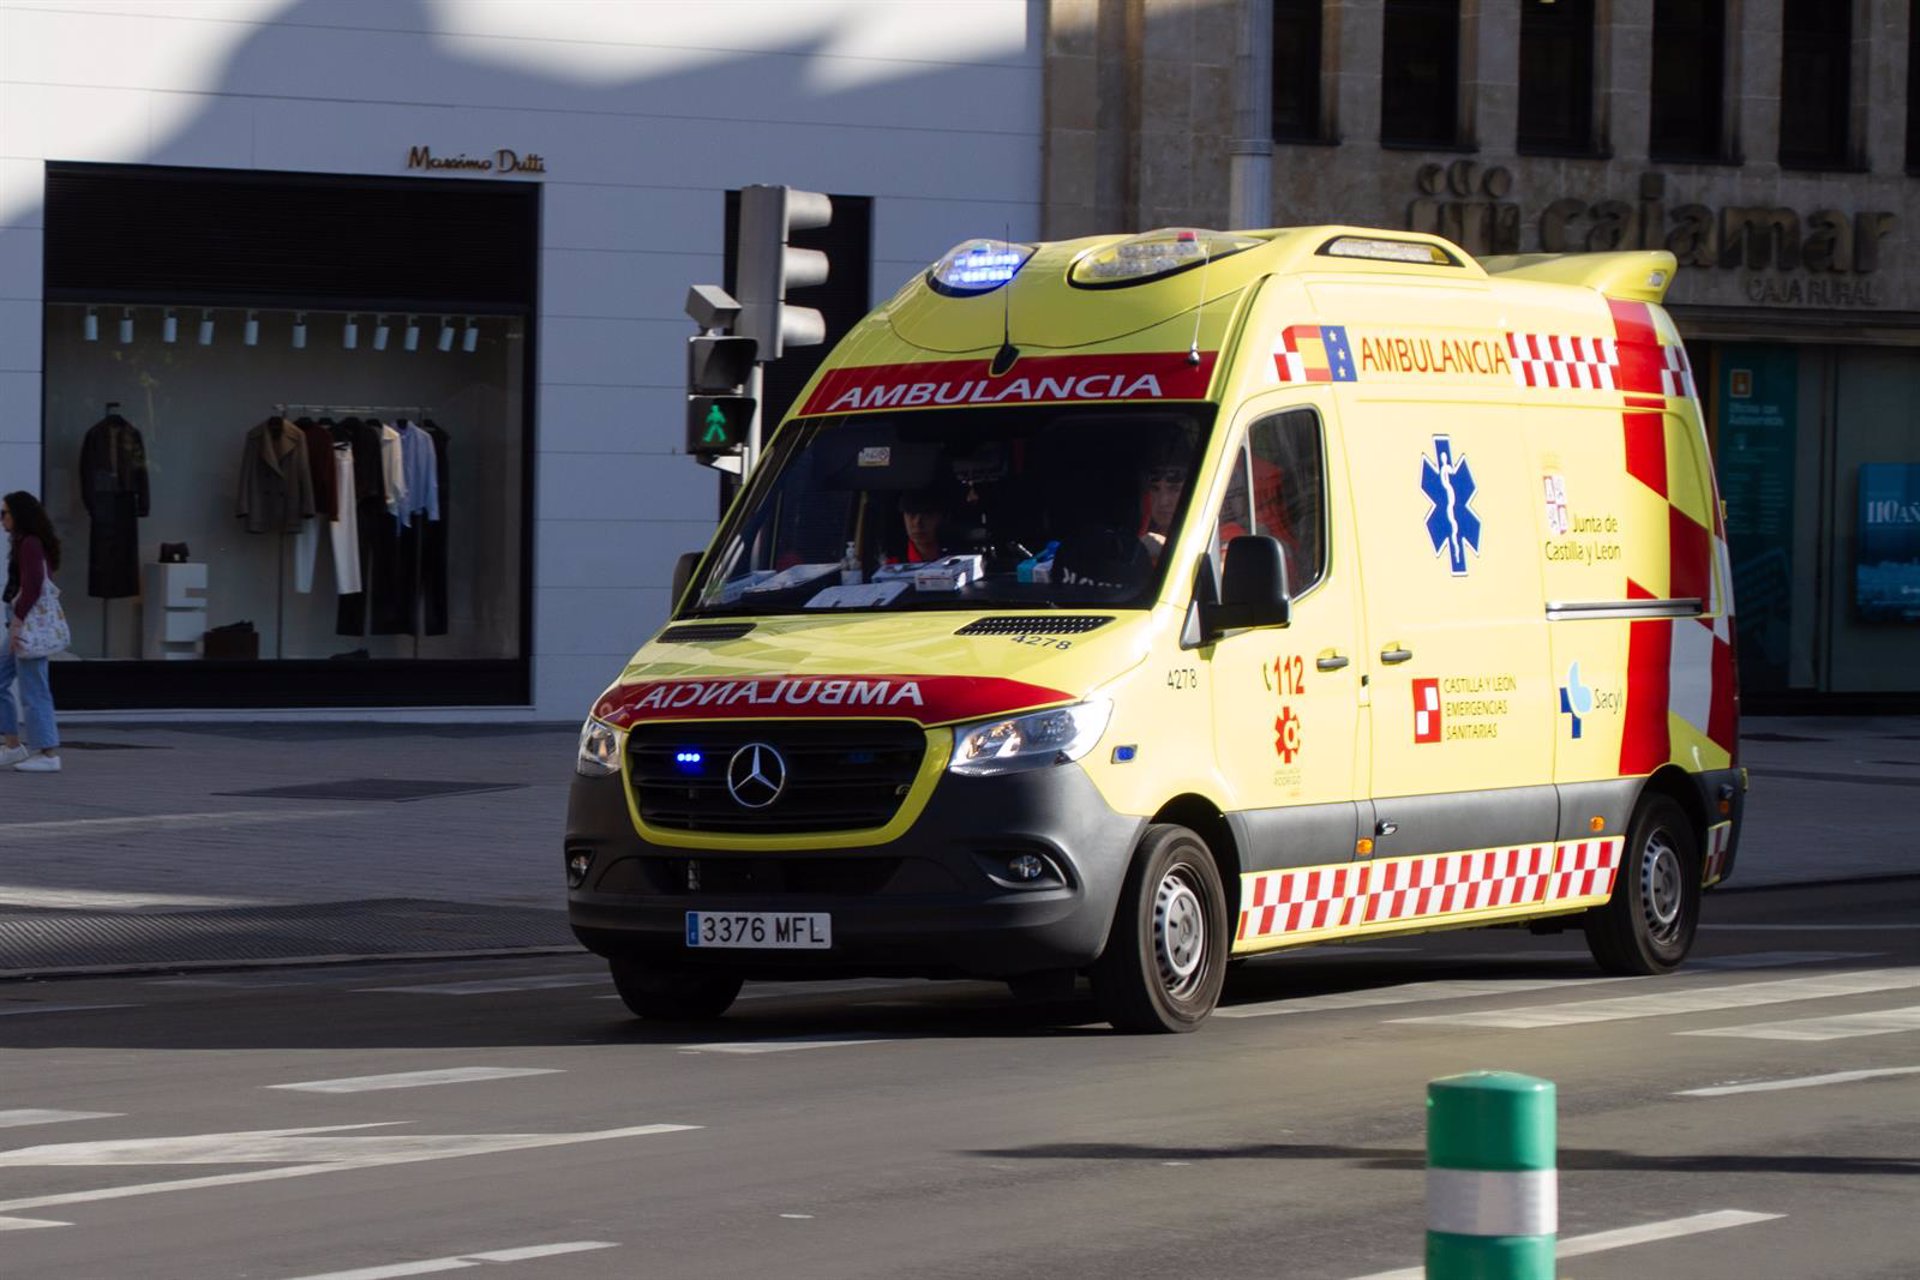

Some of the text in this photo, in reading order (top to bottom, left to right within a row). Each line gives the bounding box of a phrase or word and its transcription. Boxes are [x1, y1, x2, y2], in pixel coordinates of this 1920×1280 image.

[407, 145, 546, 174] Massimo Dutti
[1539, 171, 1896, 275] cajamar
[1746, 277, 1878, 306] CAJA RURAL
[1362, 336, 1511, 375] AMBULANCIA
[826, 374, 1163, 411] AMBULANCIA
[1573, 513, 1618, 533] Junta de
[1545, 541, 1583, 561] Castilla
[1586, 545, 1593, 566] y
[1012, 635, 1072, 650] 4278
[1167, 669, 1198, 690] 4278
[1274, 655, 1305, 695] 112
[1444, 676, 1484, 693] CASTILLA
[1446, 700, 1508, 717] EMERGENCIAS
[1594, 688, 1623, 715] Sacyl
[1446, 723, 1498, 741] SANITARIAS
[703, 917, 825, 943] 3376 MFL
